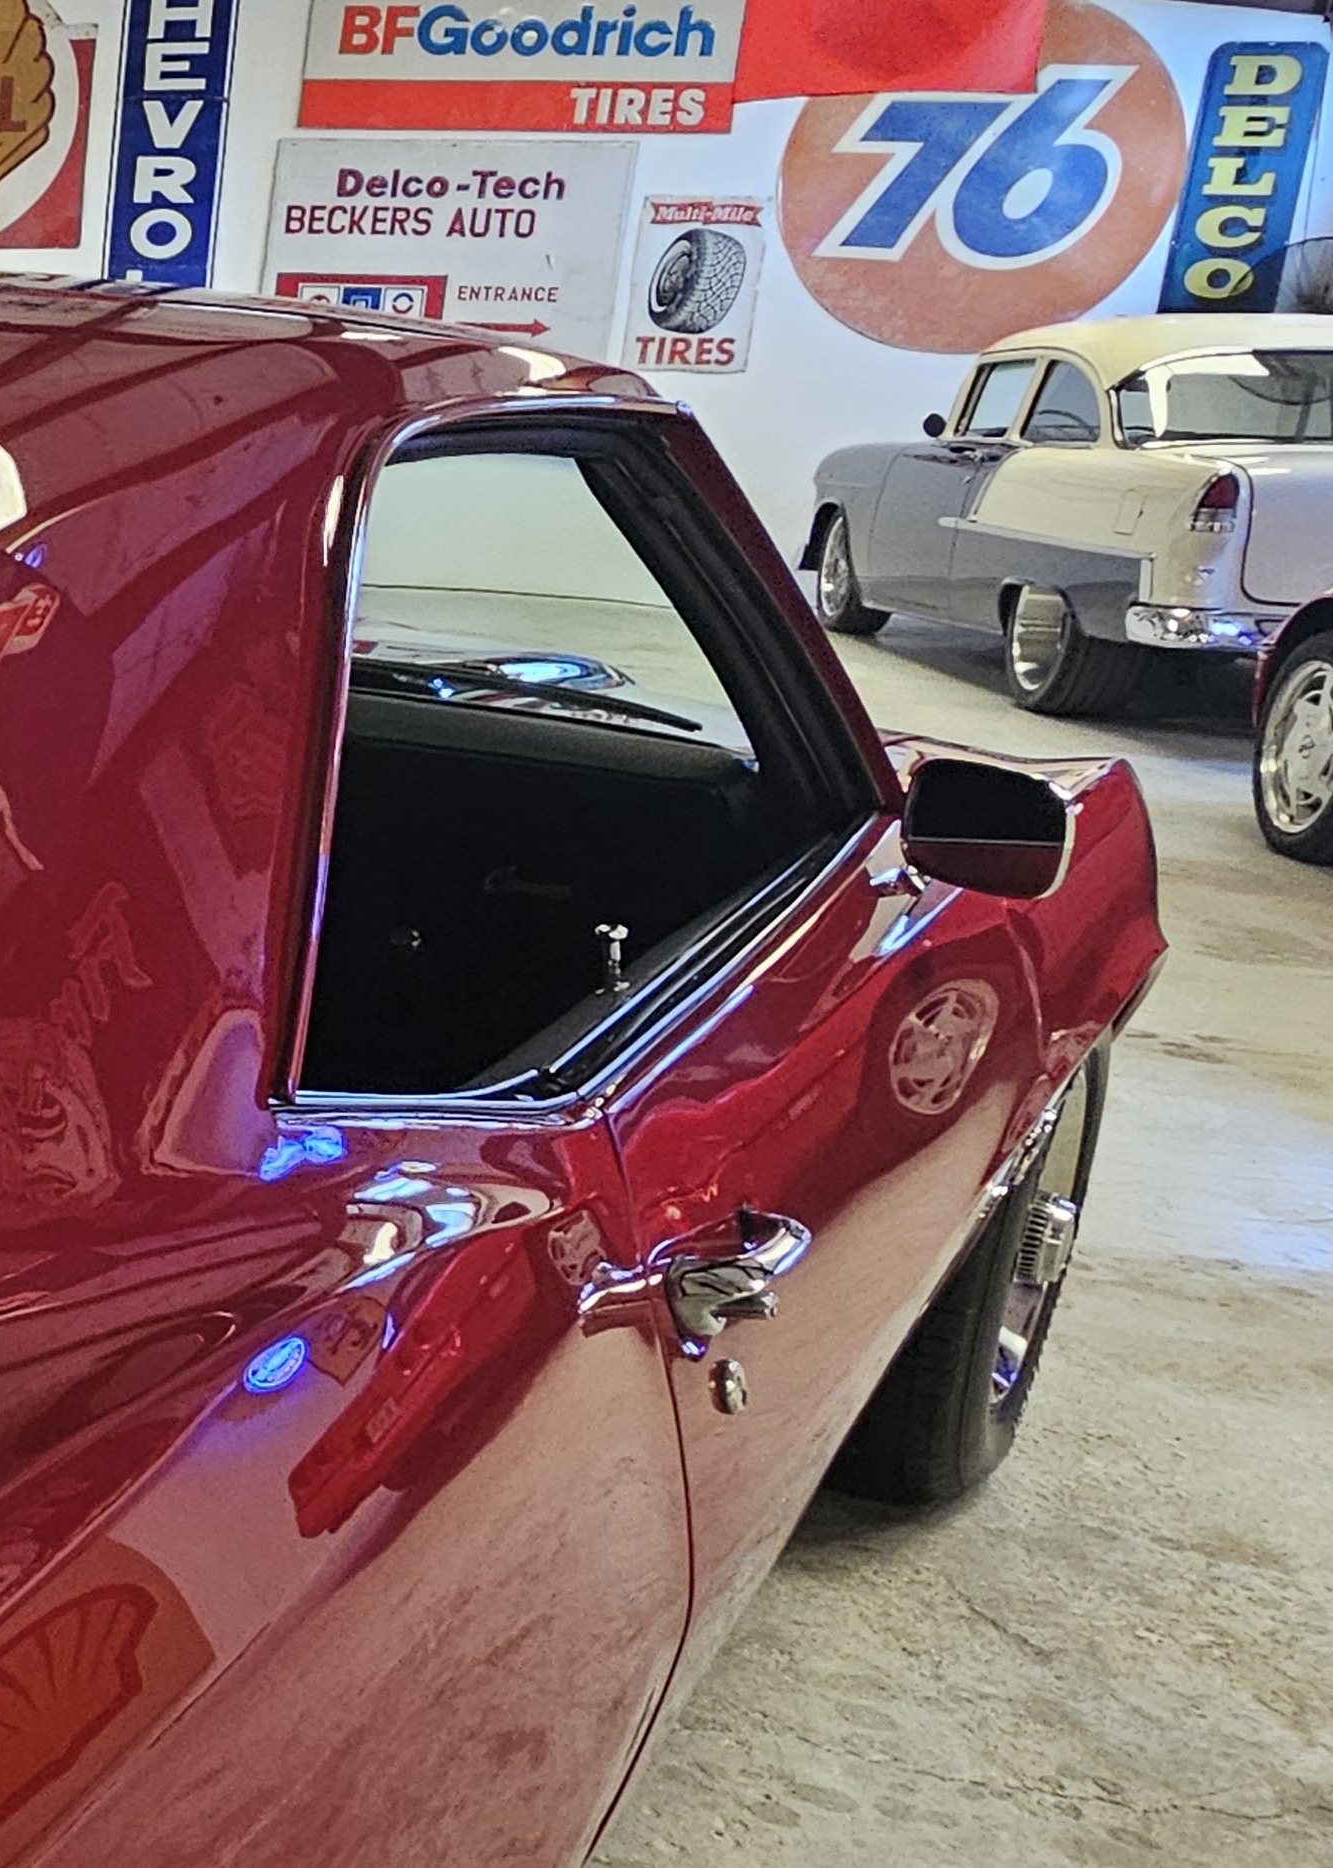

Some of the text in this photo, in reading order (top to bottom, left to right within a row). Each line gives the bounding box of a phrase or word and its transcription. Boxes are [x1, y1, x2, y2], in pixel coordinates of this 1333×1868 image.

[338, 3, 716, 57] BFGoodrich
[570, 87, 707, 126] TIRES
[126, 0, 213, 282] HEVRO
[811, 64, 1140, 270] 76
[1184, 54, 1303, 299] DELCO
[285, 205, 537, 239] BECKERS AUTO
[655, 205, 755, 222] Multi-Mile
[457, 285, 559, 303] ENTRANCE
[635, 335, 736, 366] TIRES
